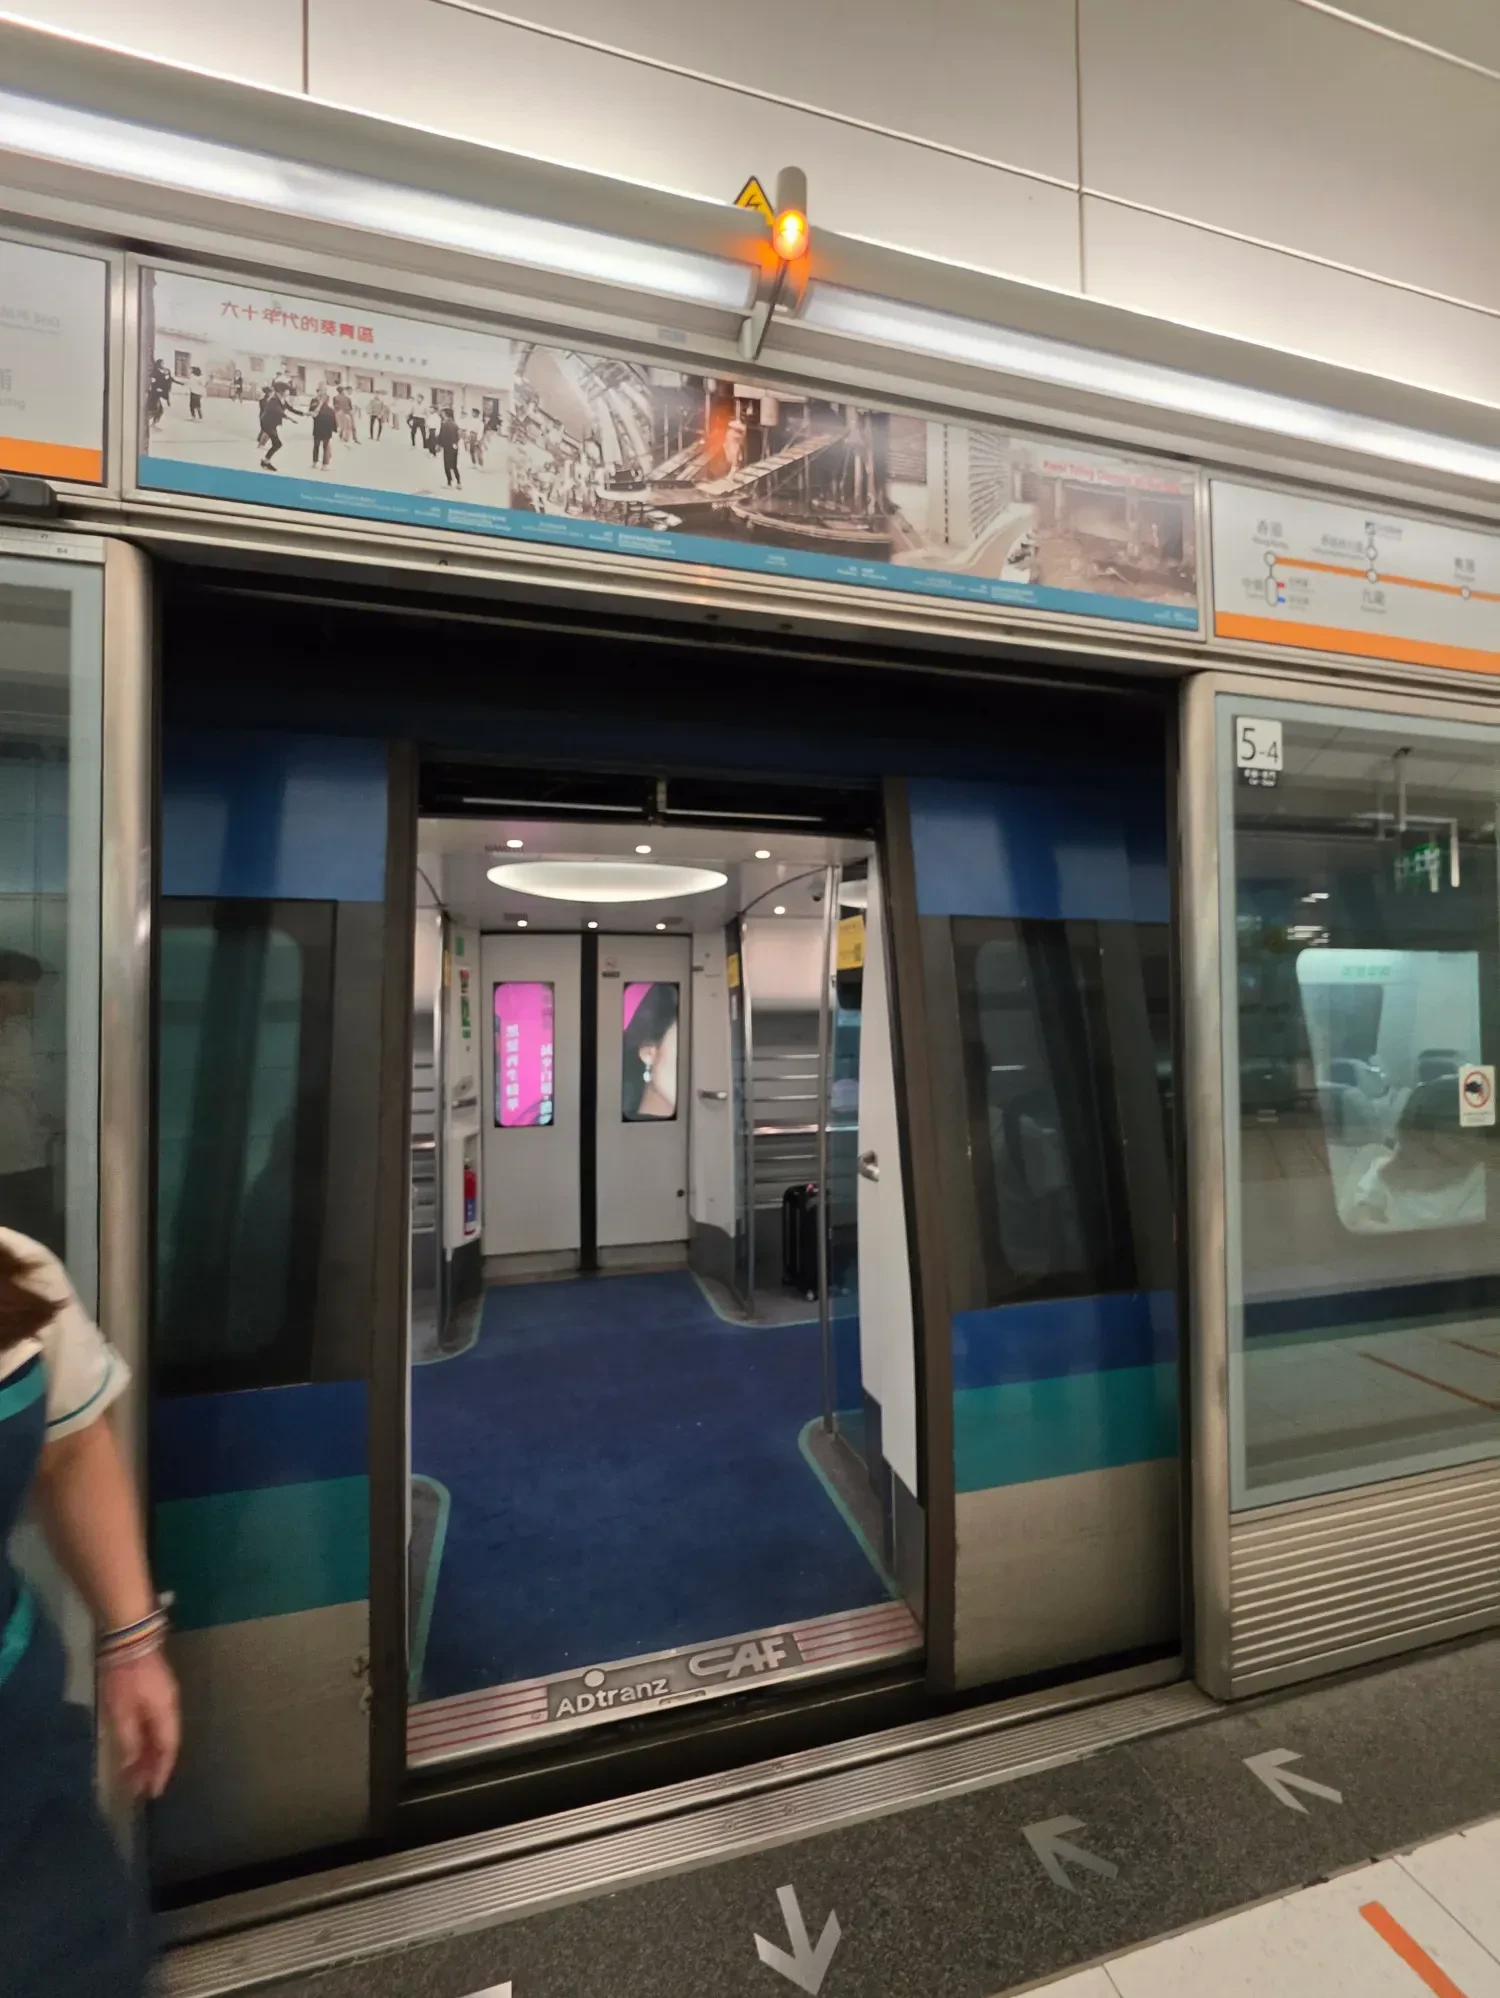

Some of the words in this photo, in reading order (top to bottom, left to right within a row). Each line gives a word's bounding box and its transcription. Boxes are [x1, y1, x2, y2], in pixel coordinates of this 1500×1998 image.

[1241, 727, 1279, 764] 5-4
[688, 1637, 787, 1678] CAF
[556, 1678, 669, 1718] ADtranz
